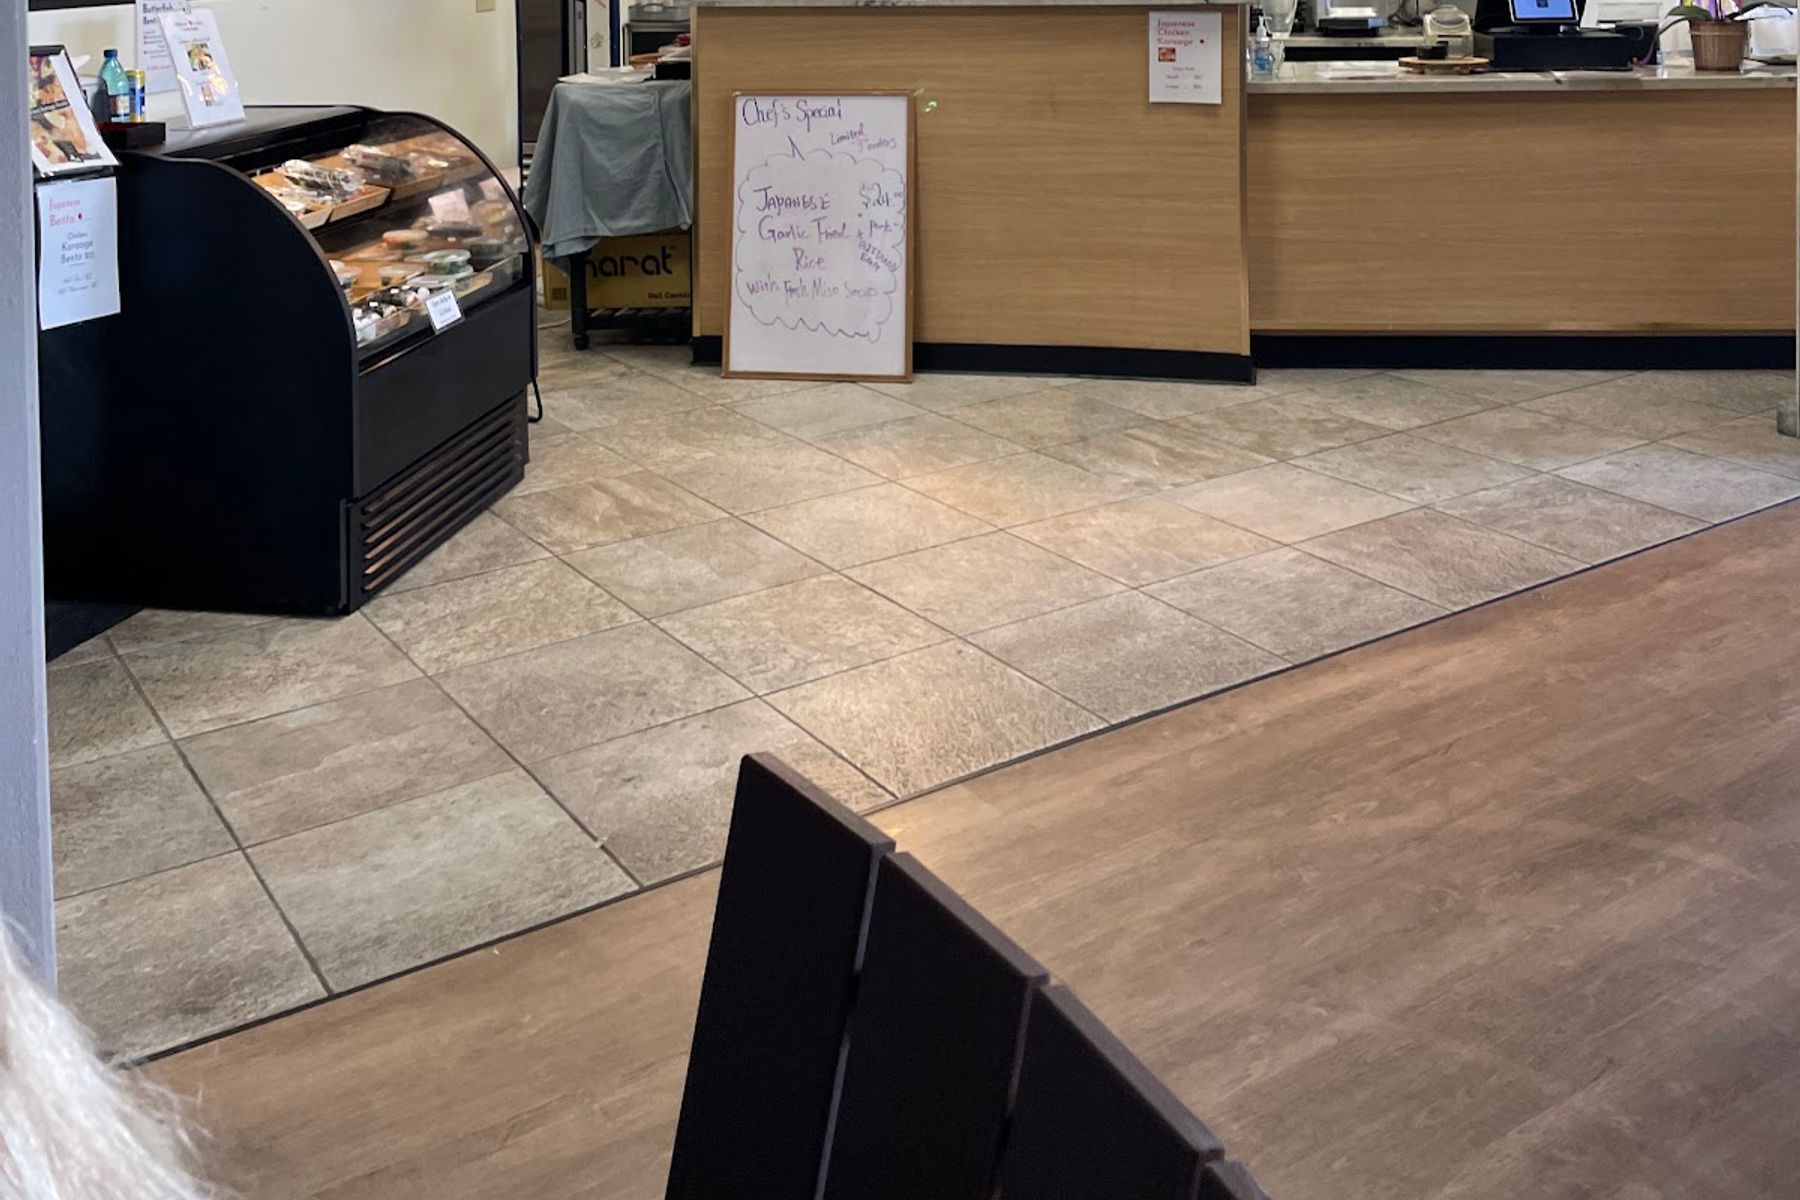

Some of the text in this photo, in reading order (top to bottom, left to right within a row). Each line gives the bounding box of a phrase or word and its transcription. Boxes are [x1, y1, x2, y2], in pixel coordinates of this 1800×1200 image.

[742, 97, 842, 133] Chef's Special
[49, 214, 75, 227] Bento
[758, 215, 811, 244] Garlic
[792, 246, 829, 271] Rice
[812, 278, 839, 299] Miso
